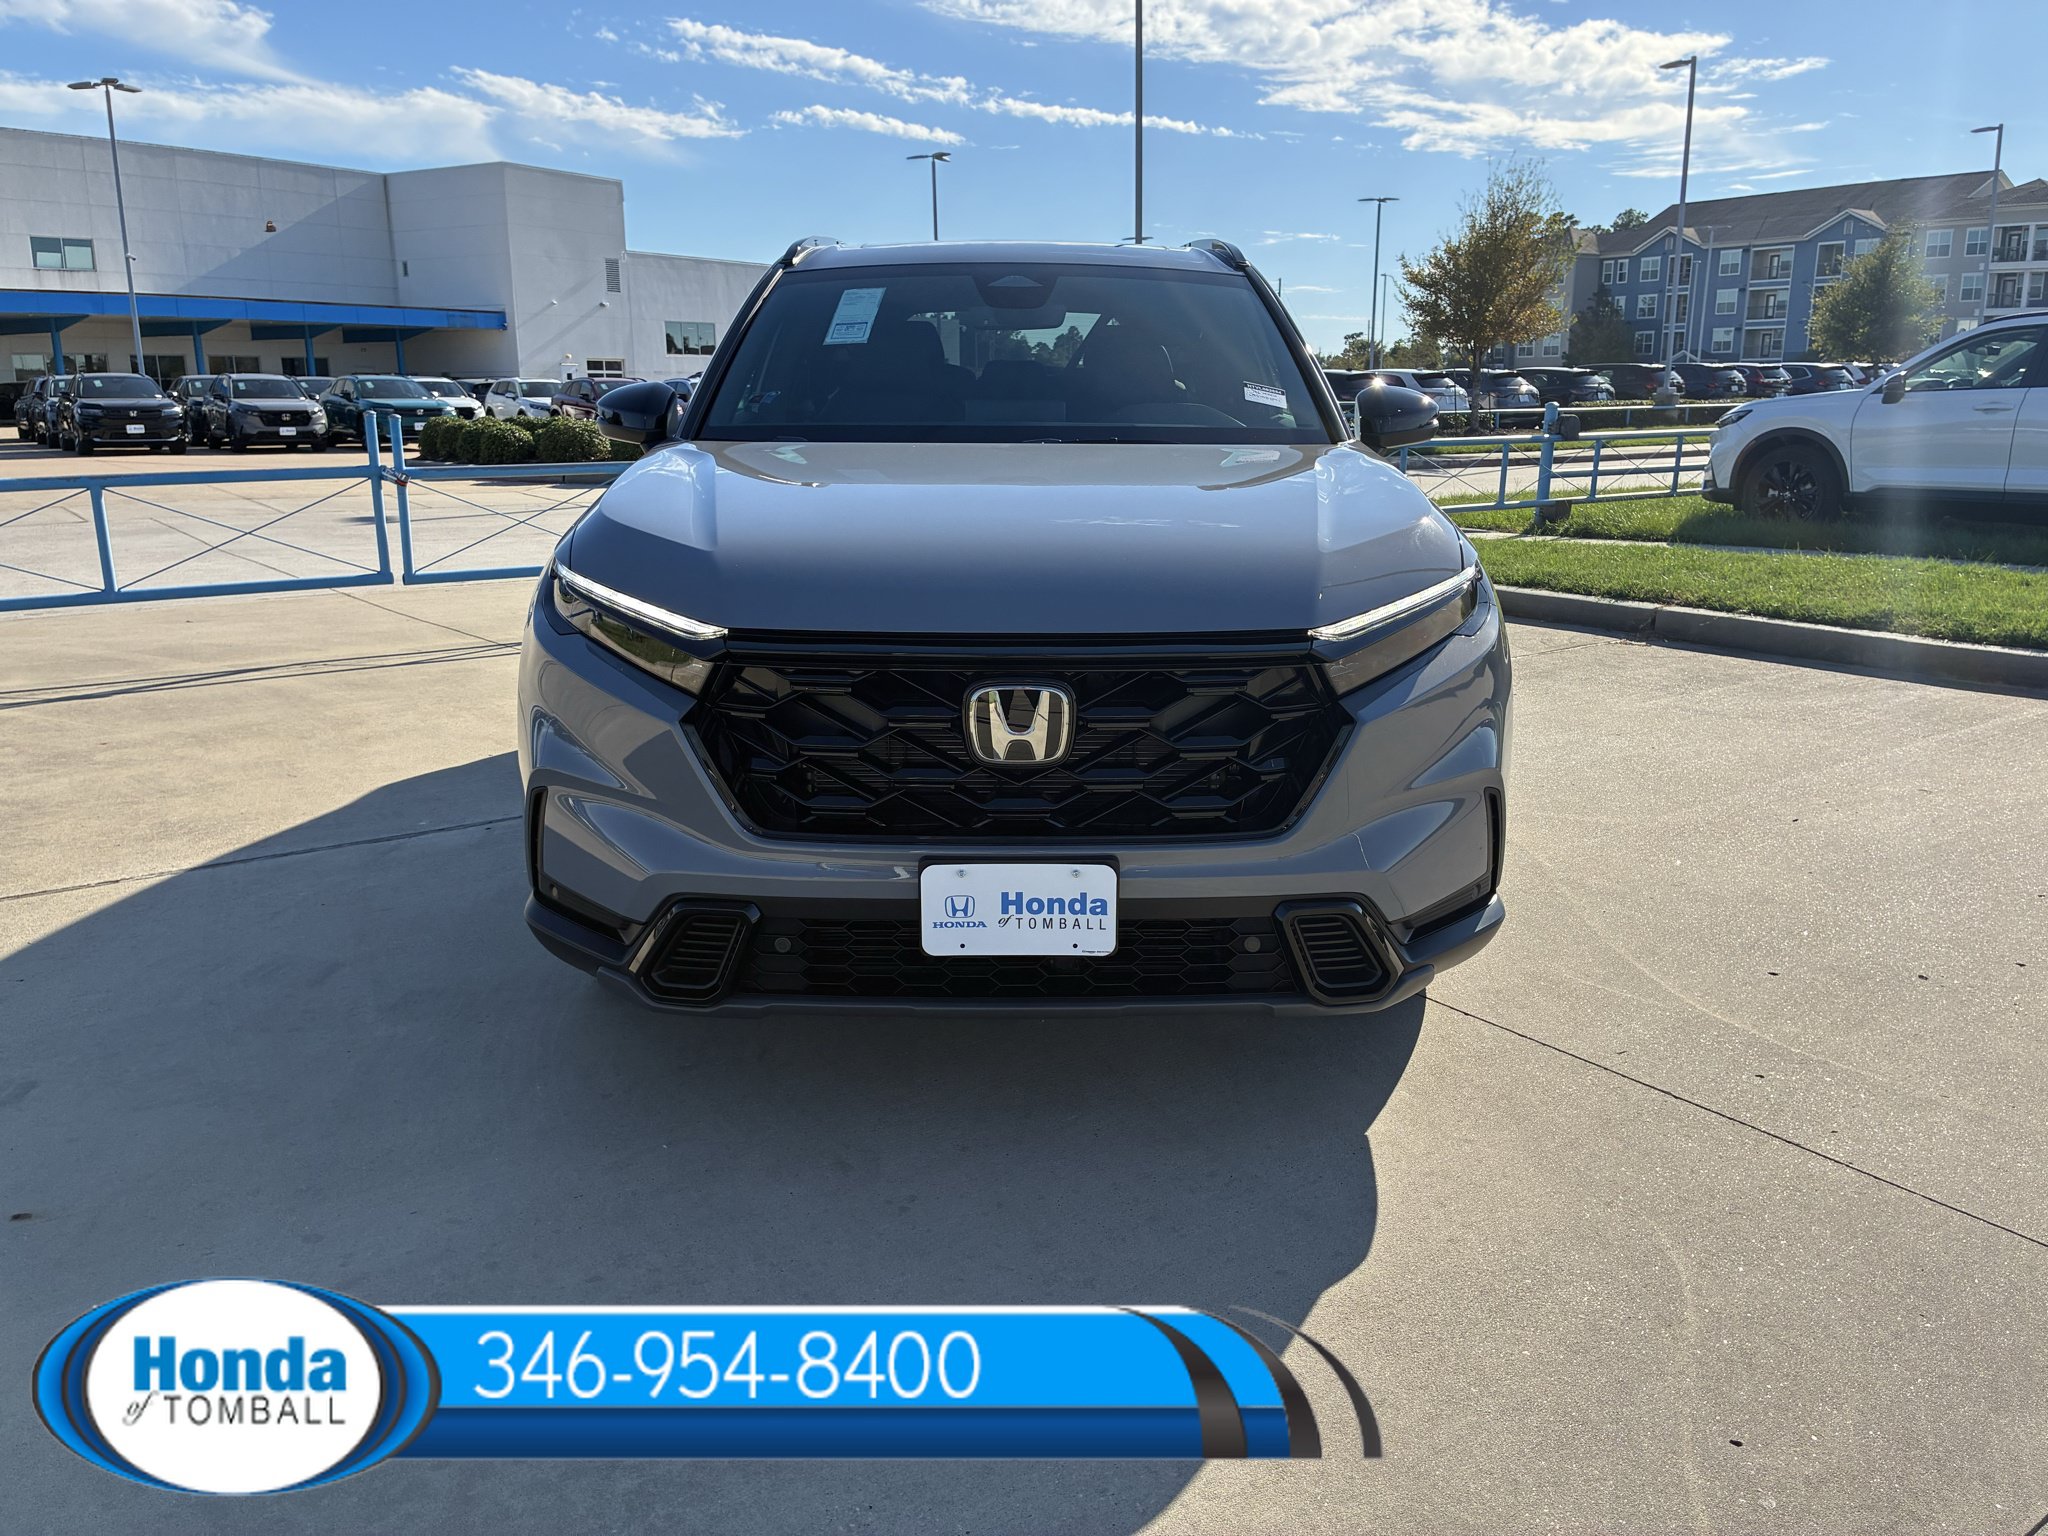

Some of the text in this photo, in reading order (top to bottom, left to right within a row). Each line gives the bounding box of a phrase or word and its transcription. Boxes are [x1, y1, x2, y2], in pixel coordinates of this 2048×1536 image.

[1001, 892, 1108, 916] Honda
[933, 921, 988, 929] HONDA
[998, 914, 1107, 930] of TOMBALL
